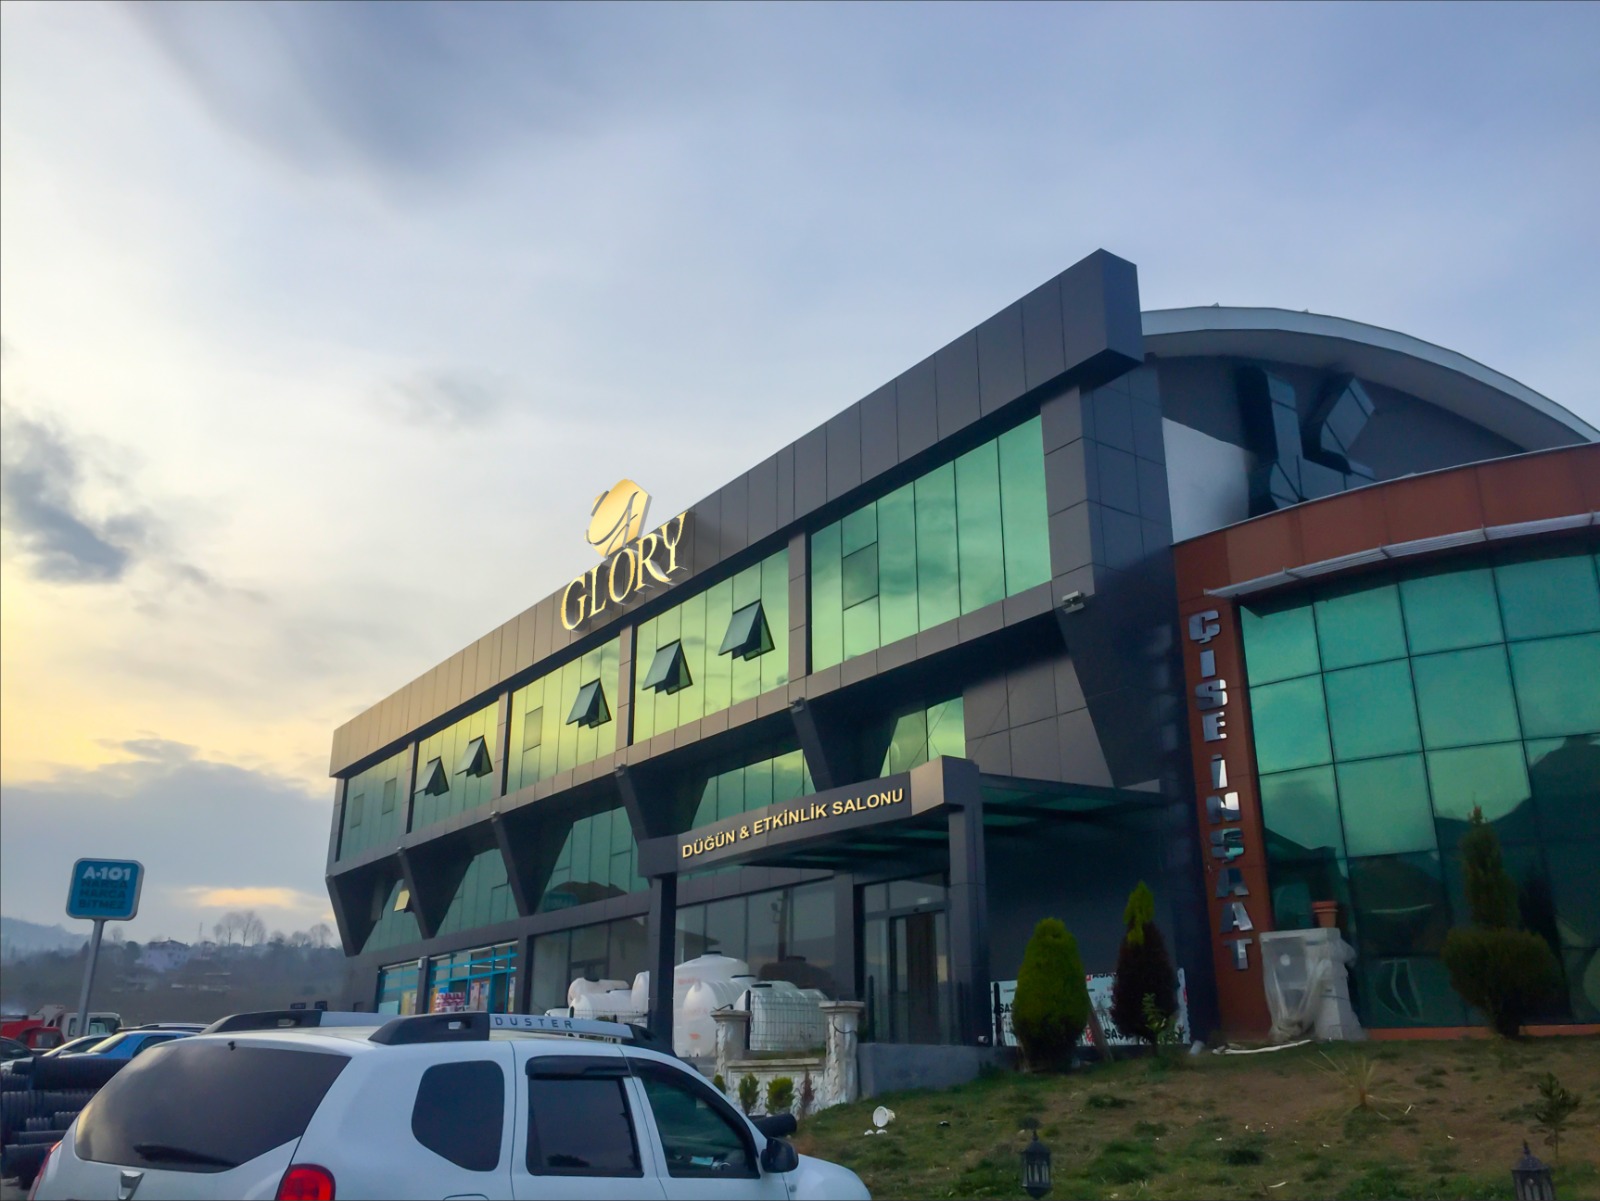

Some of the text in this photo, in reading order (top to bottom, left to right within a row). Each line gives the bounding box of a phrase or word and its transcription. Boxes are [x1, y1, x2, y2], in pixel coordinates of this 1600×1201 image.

[560, 511, 689, 630] GLORY
[682, 788, 904, 858] DÜĞÜN & ETKİNLİK SALONU
[494, 1016, 573, 1030] DUSTER
